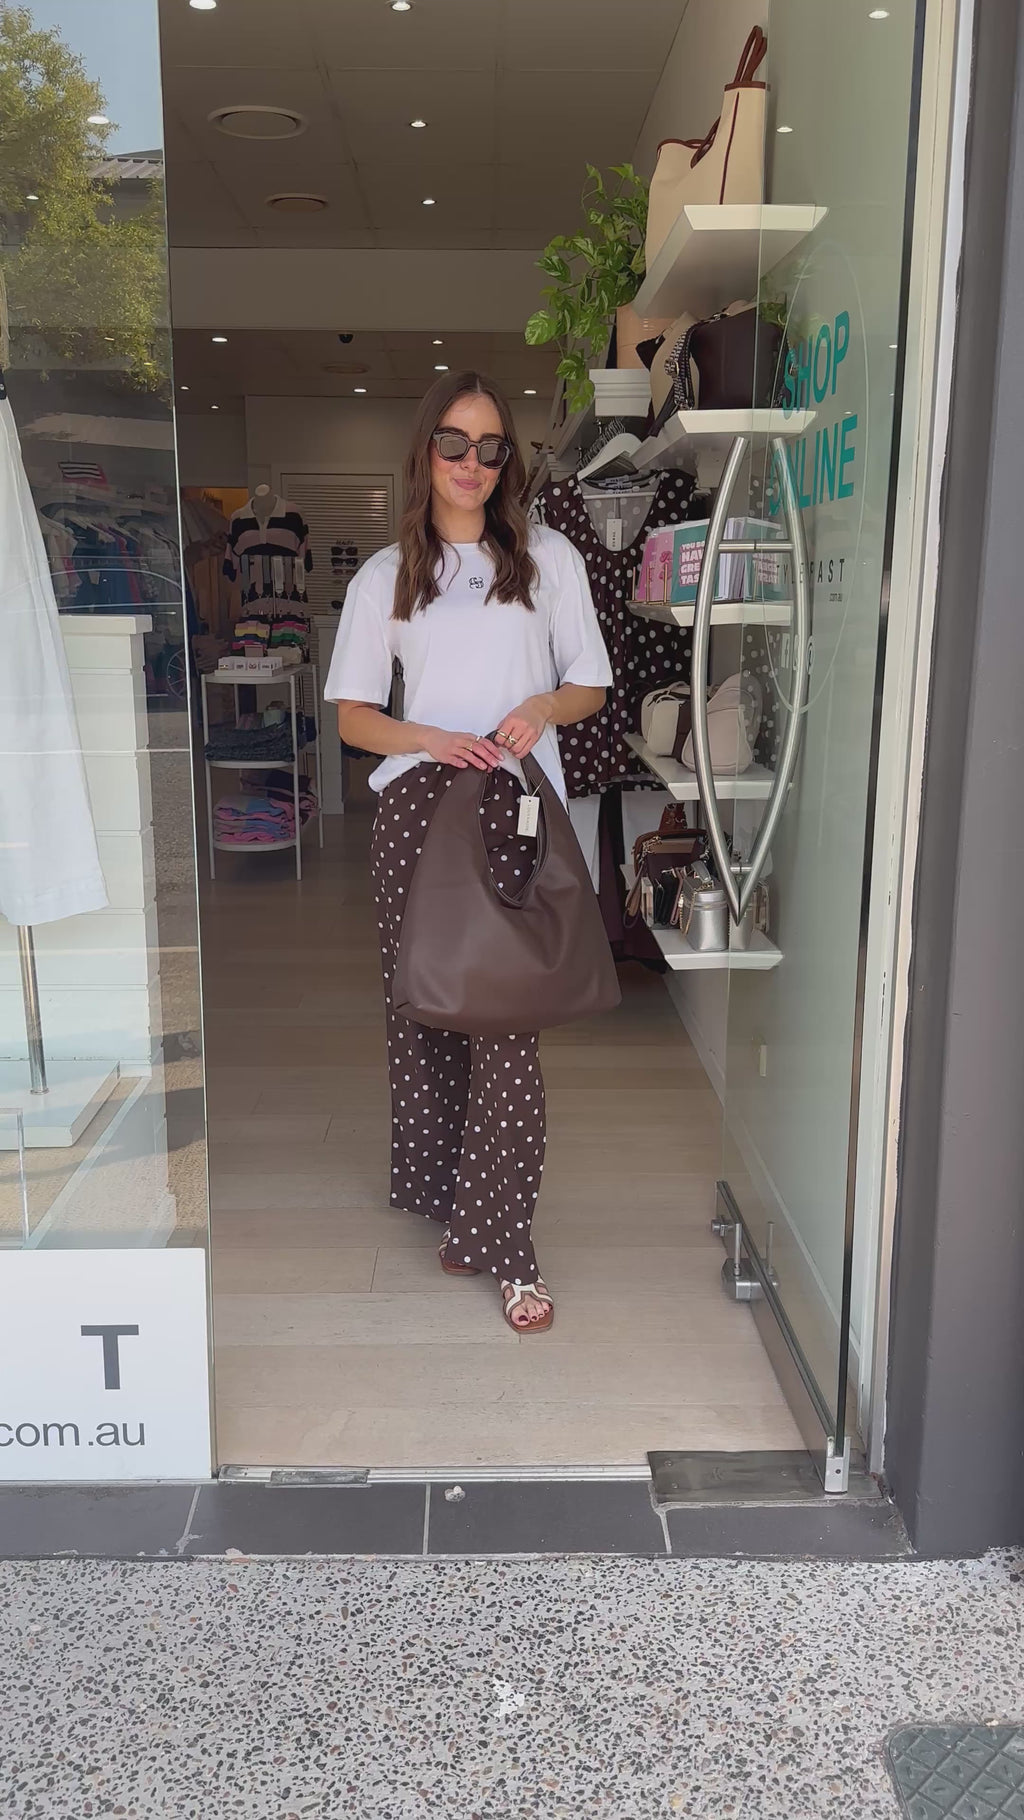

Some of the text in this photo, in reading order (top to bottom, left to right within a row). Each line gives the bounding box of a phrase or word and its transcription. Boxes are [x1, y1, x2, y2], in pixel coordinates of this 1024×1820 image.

[782, 310, 849, 420] SHOP
[769, 414, 858, 516] ONLINE
[680, 562, 701, 574] GRE
[681, 549, 704, 563] HAV
[680, 573, 700, 585] TAS
[80, 1324, 139, 1390] T
